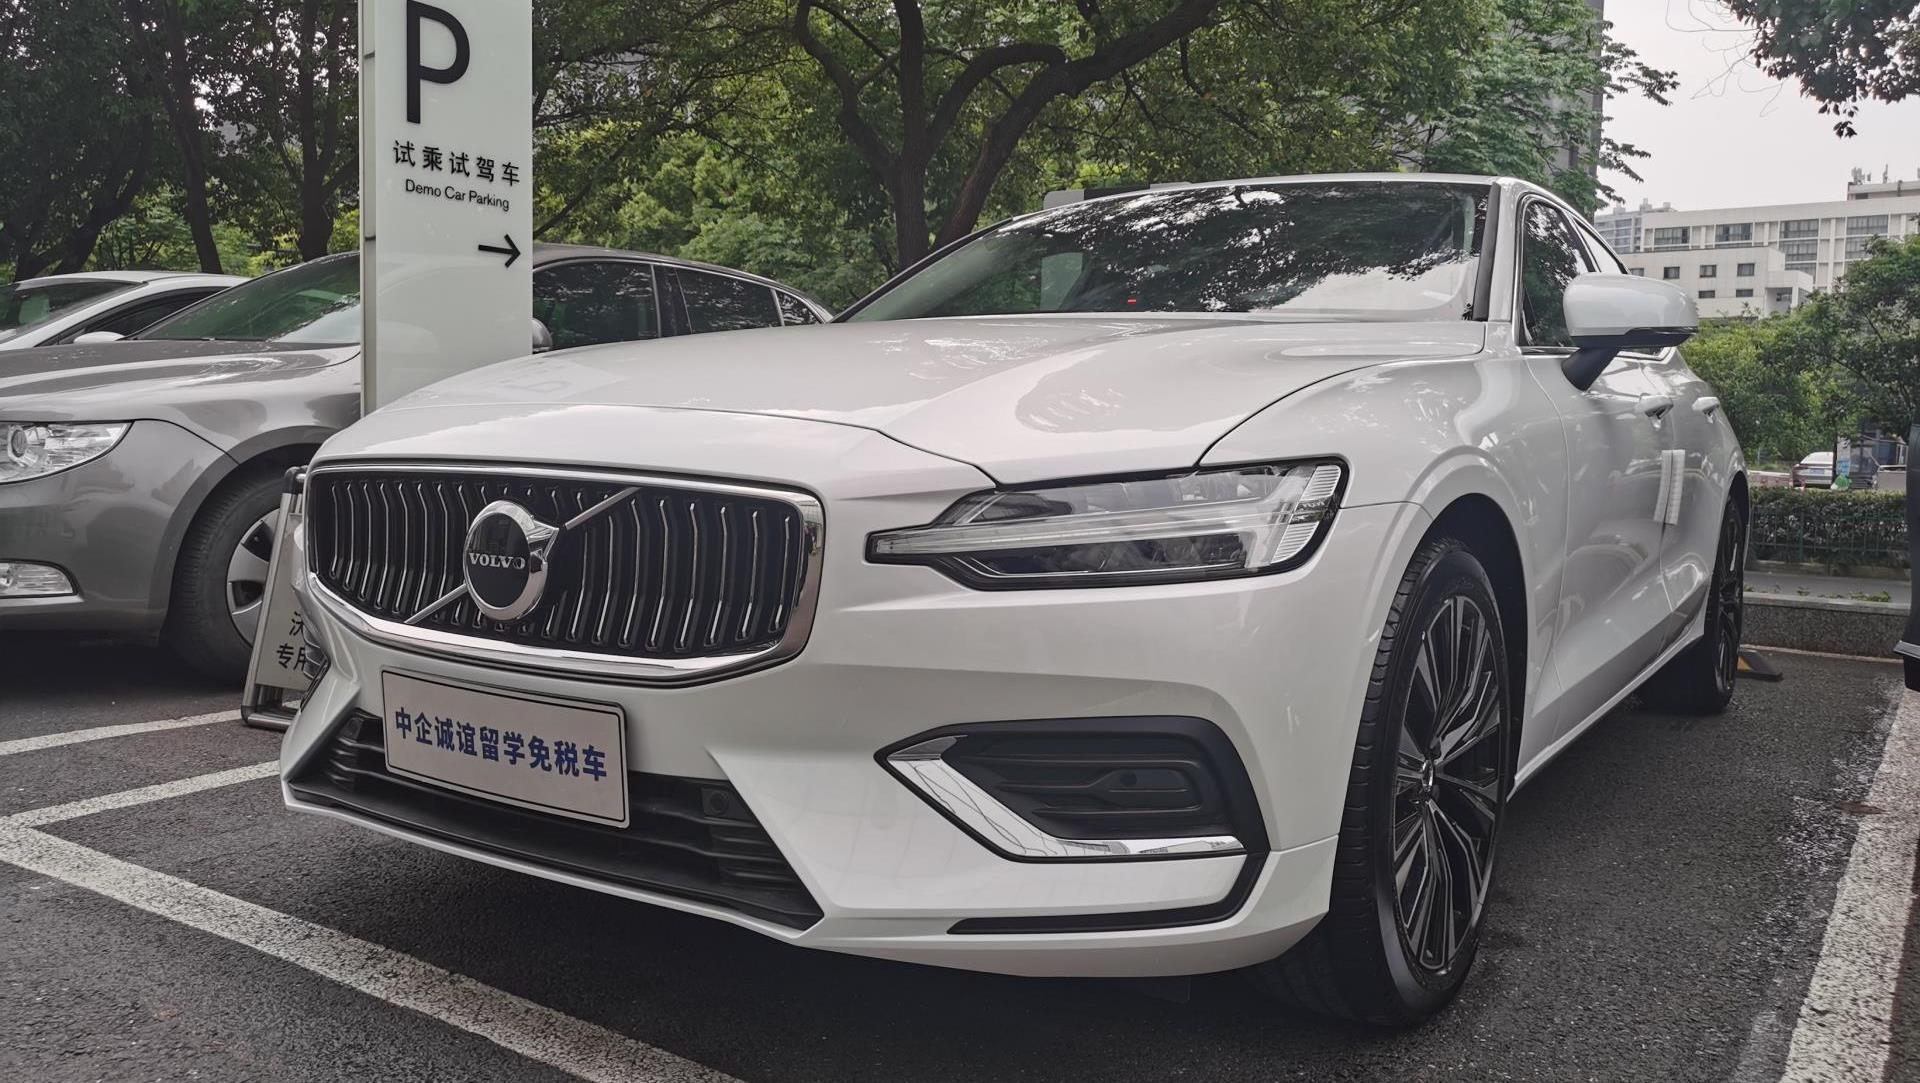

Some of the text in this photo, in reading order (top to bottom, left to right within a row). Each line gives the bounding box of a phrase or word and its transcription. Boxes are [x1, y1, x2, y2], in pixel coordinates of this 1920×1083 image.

[406, 0, 471, 125] P
[392, 140, 521, 188] 试乘试驾车
[405, 178, 510, 212] Demo Car Parking
[468, 552, 526, 570] VOLVO
[395, 706, 608, 782] 中企诚谊留学免税车
